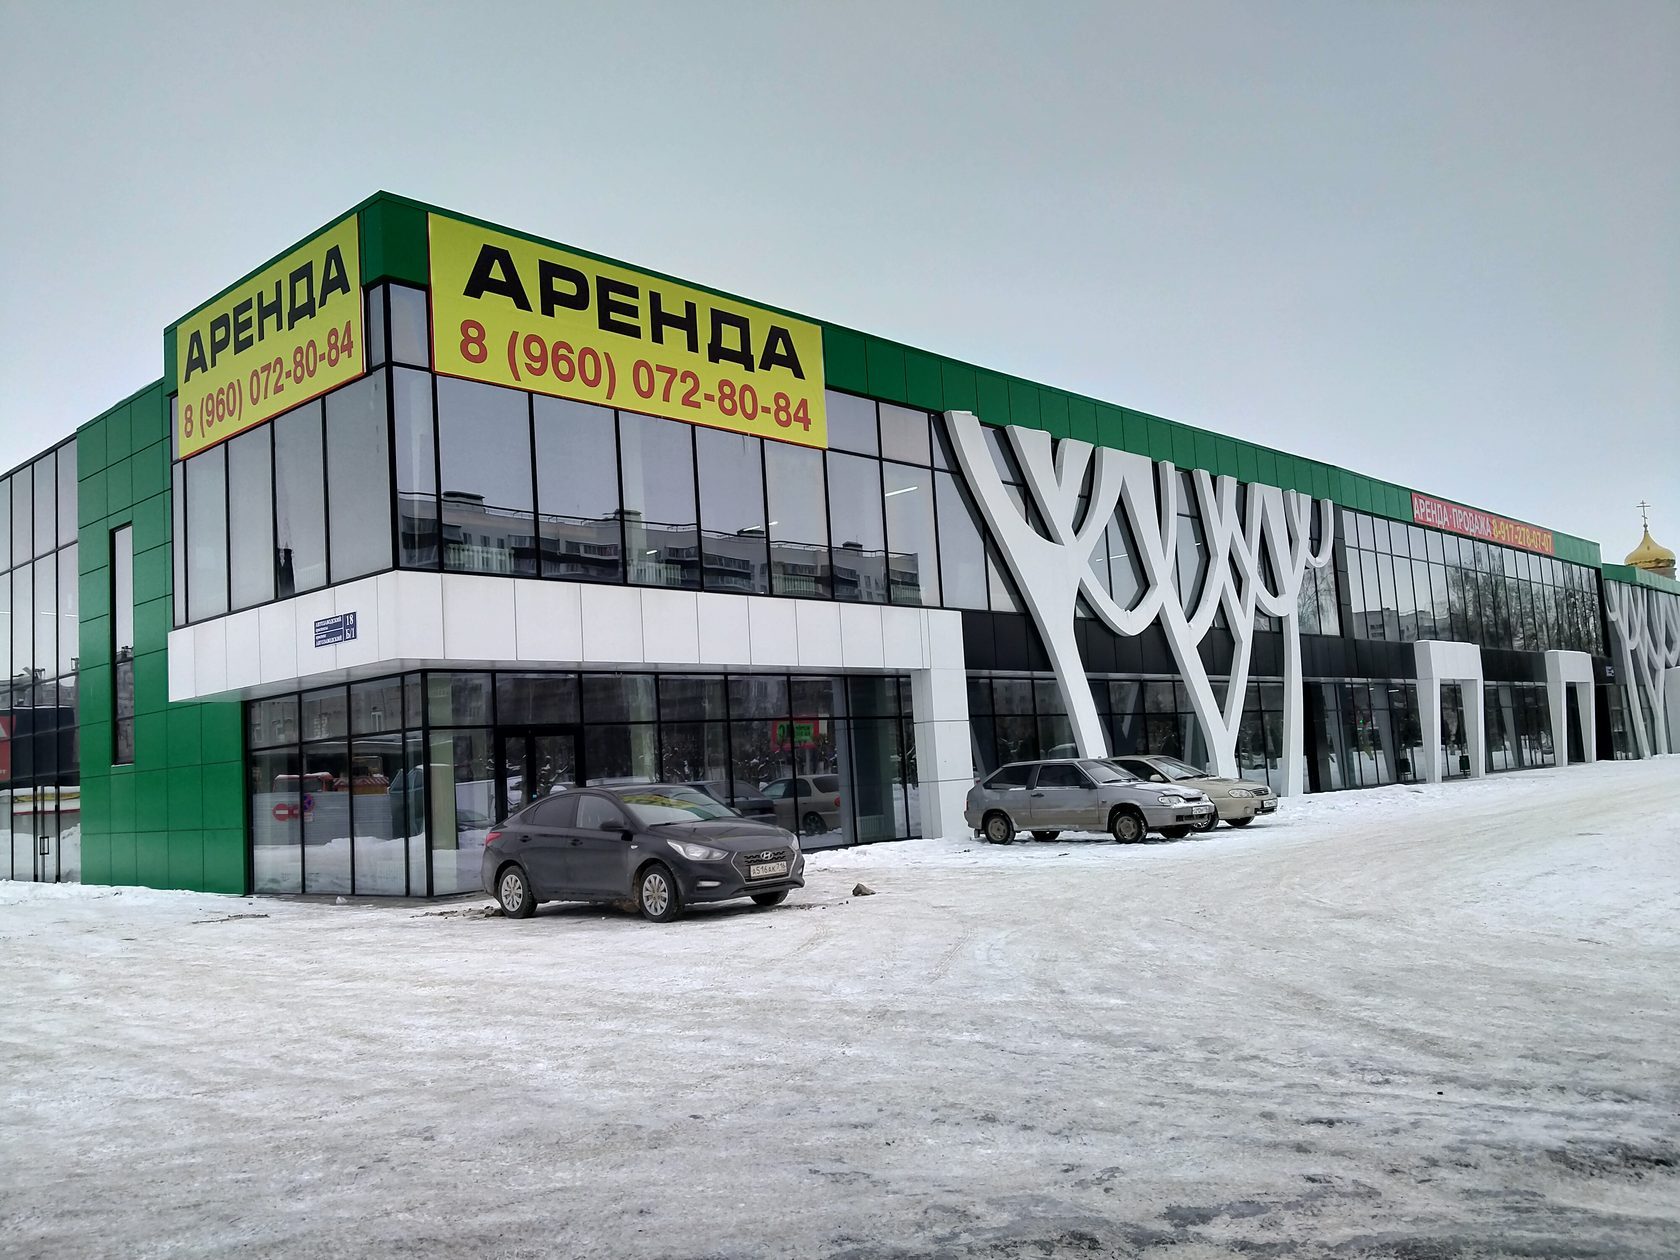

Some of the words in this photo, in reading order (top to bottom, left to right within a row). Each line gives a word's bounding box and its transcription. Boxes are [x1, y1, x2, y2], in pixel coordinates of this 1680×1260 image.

[184, 244, 350, 383] АРЕНДА
[463, 243, 806, 381] АРЕНДА
[184, 404, 193, 438] 8
[199, 378, 244, 437] (960)
[249, 320, 354, 406] 072-80-84
[460, 319, 488, 364] 8
[507, 330, 617, 400] (960)
[632, 359, 812, 431] 072-80-84
[346, 614, 354, 625] 18
